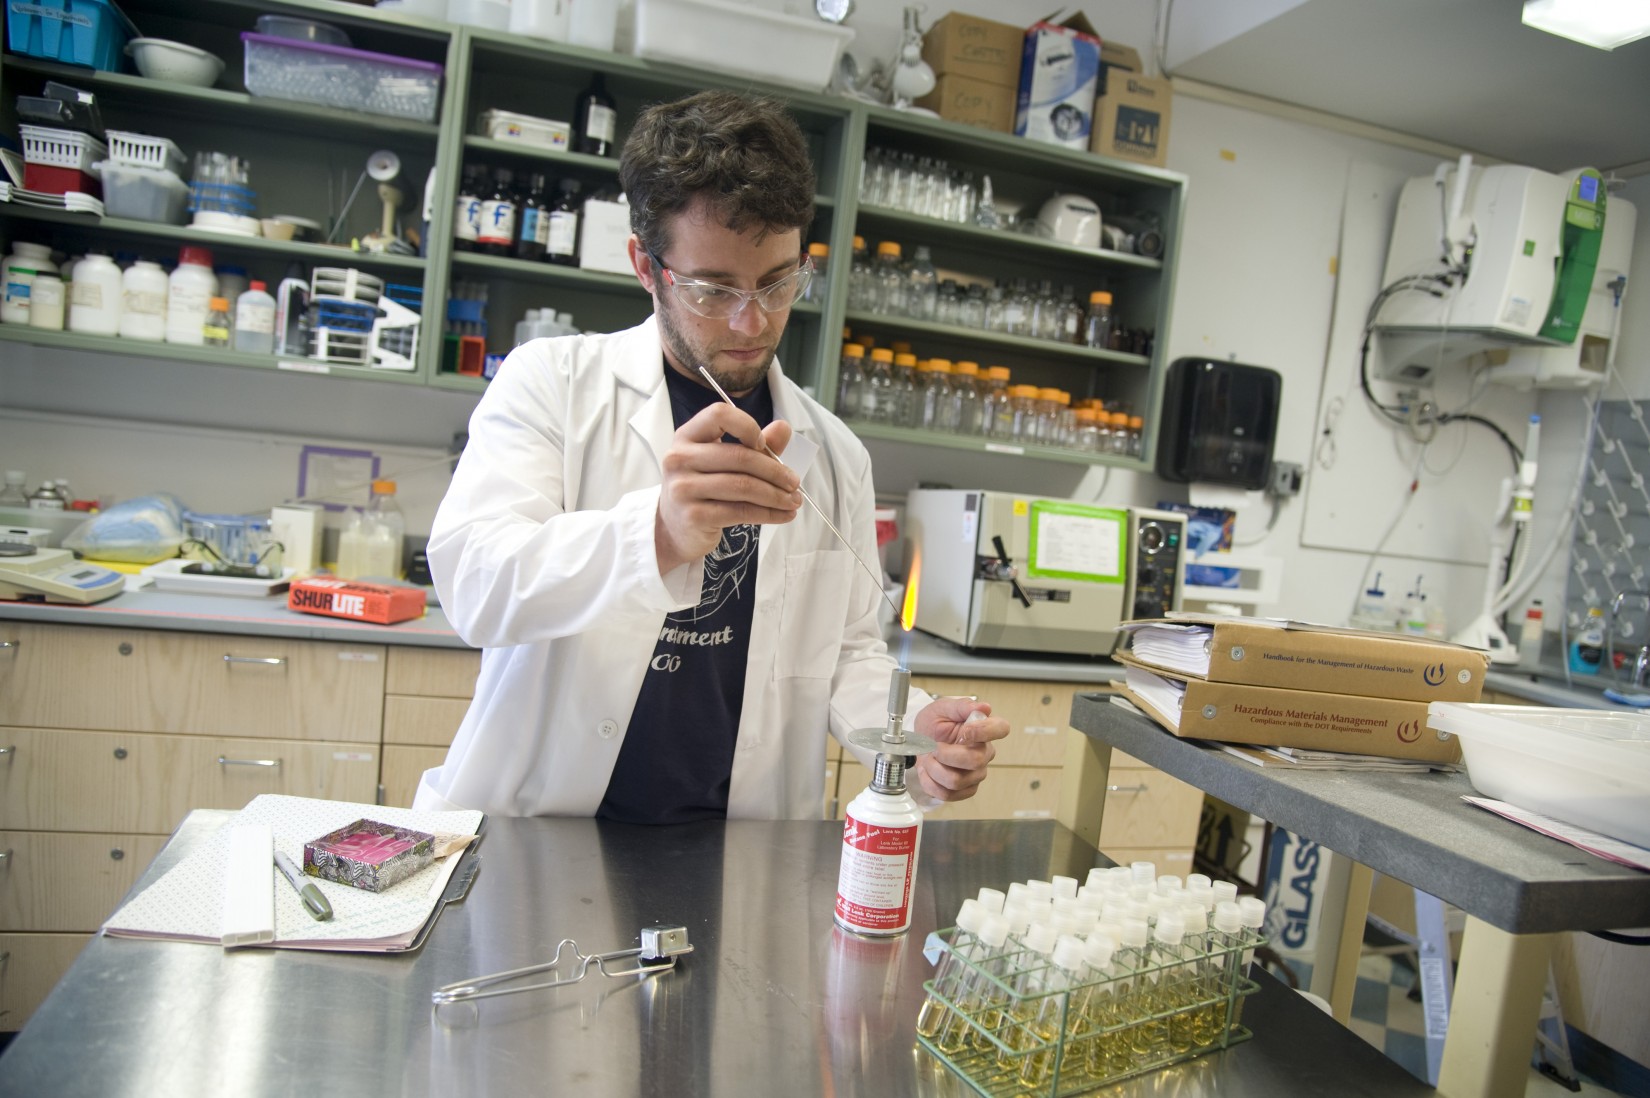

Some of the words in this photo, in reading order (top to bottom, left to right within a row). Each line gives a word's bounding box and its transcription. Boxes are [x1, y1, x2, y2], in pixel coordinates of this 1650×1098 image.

[291, 588, 366, 617] SHURLITE
[1263, 652, 1295, 662] Handbook
[1295, 655, 1305, 664] for
[1306, 657, 1316, 665] the
[1317, 658, 1356, 669] Management
[1364, 663, 1396, 673] Hazardous
[1396, 667, 1415, 675] Waste
[1234, 703, 1283, 718] Hazardous
[1285, 709, 1328, 722] Materials
[1329, 714, 1388, 729] Management
[1250, 716, 1287, 727] Compliance
[1288, 720, 1302, 728] with
[1303, 721, 1314, 729] the
[1331, 724, 1373, 735] Requirements
[856, 851, 883, 862] WARNING
[1281, 836, 1320, 949] GLAS
